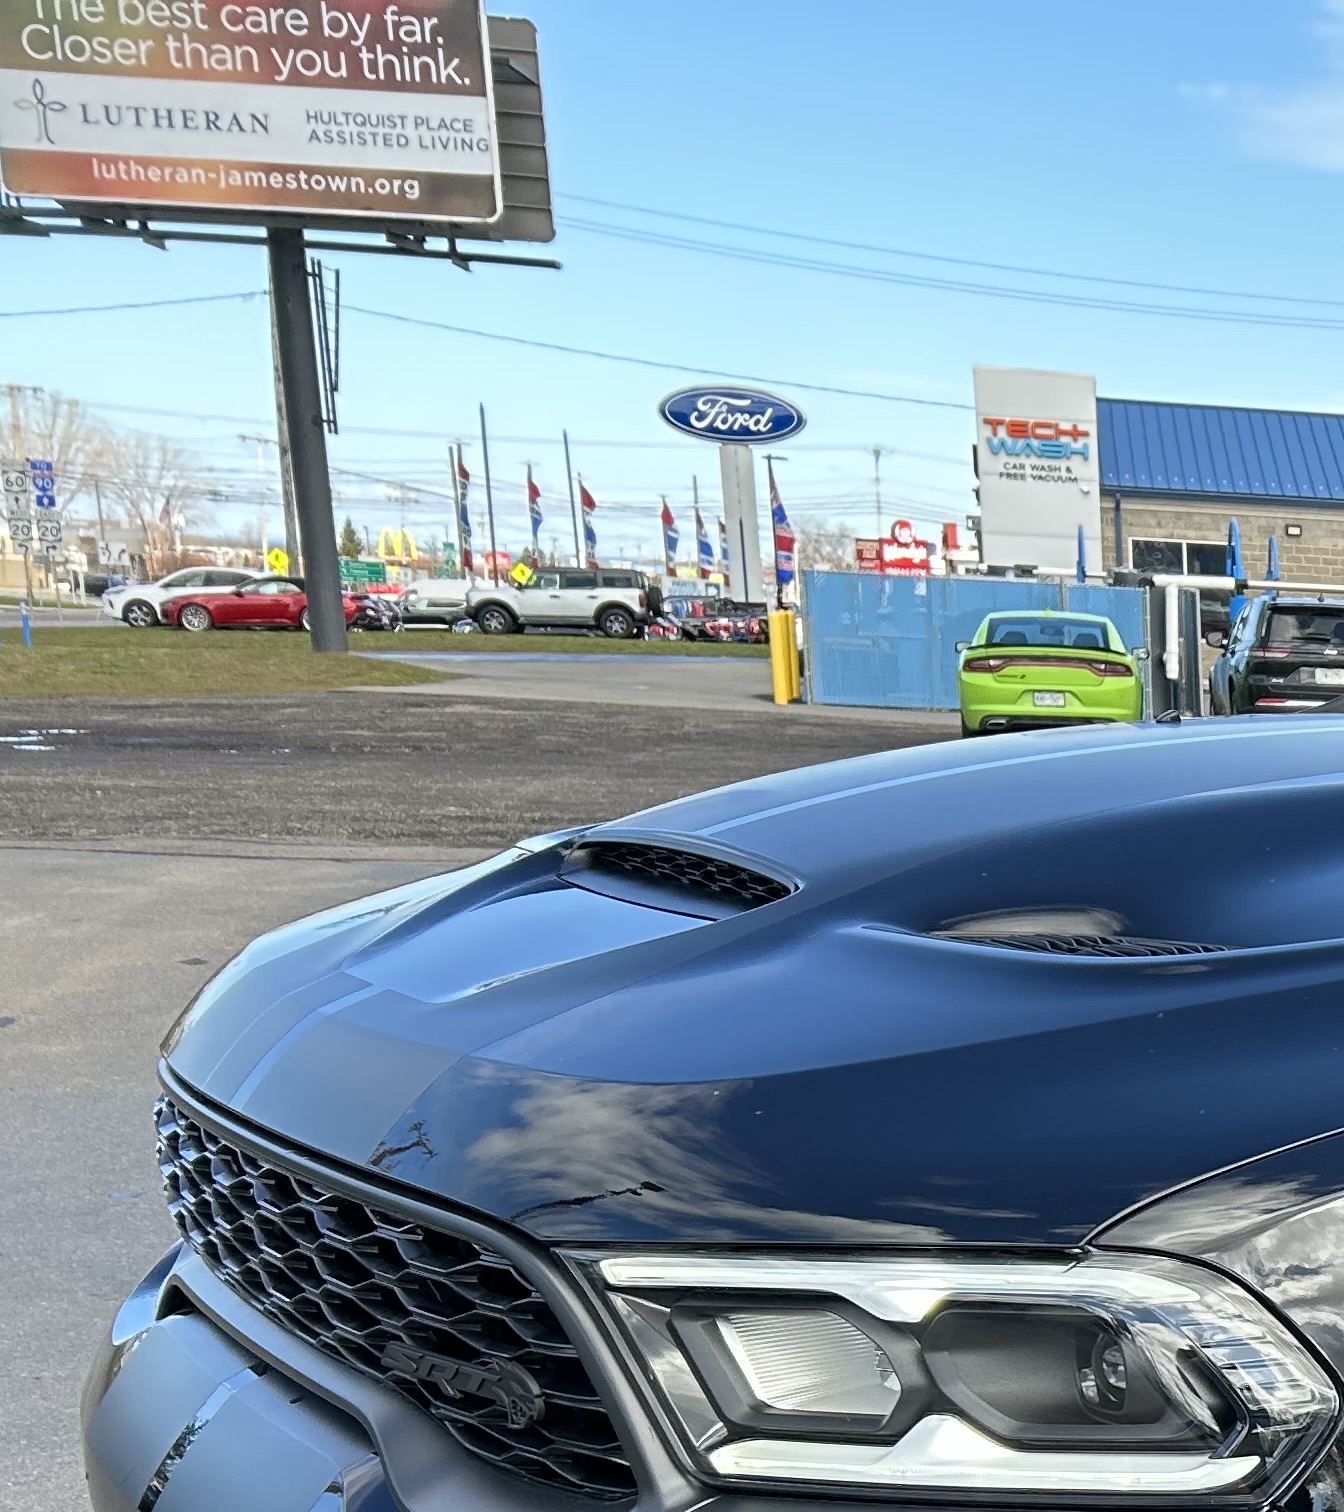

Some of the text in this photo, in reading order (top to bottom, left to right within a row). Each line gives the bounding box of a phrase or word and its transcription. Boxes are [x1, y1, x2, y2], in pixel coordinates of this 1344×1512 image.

[118, 0, 209, 30] best
[219, 3, 309, 36] care
[320, 0, 370, 46] by
[383, 4, 443, 45] far.
[21, 23, 470, 86] Closer than you think.
[81, 103, 271, 135] LUTHERAN
[306, 109, 473, 133] HULTQUIST PLACE
[308, 129, 490, 153] ASSISTED LIVING
[91, 157, 420, 199] lutheran-jamestown.org
[689, 394, 774, 432] Ford
[986, 437, 1089, 461] WASH
[999, 472, 1078, 484] FREE VACUUM
[1003, 462, 1073, 474] CAR WASH &
[5, 475, 24, 488] 60
[34, 477, 52, 487] 90
[11, 524, 30, 536] 20
[40, 525, 59, 537] 20
[381, 1342, 503, 1399] SRT
